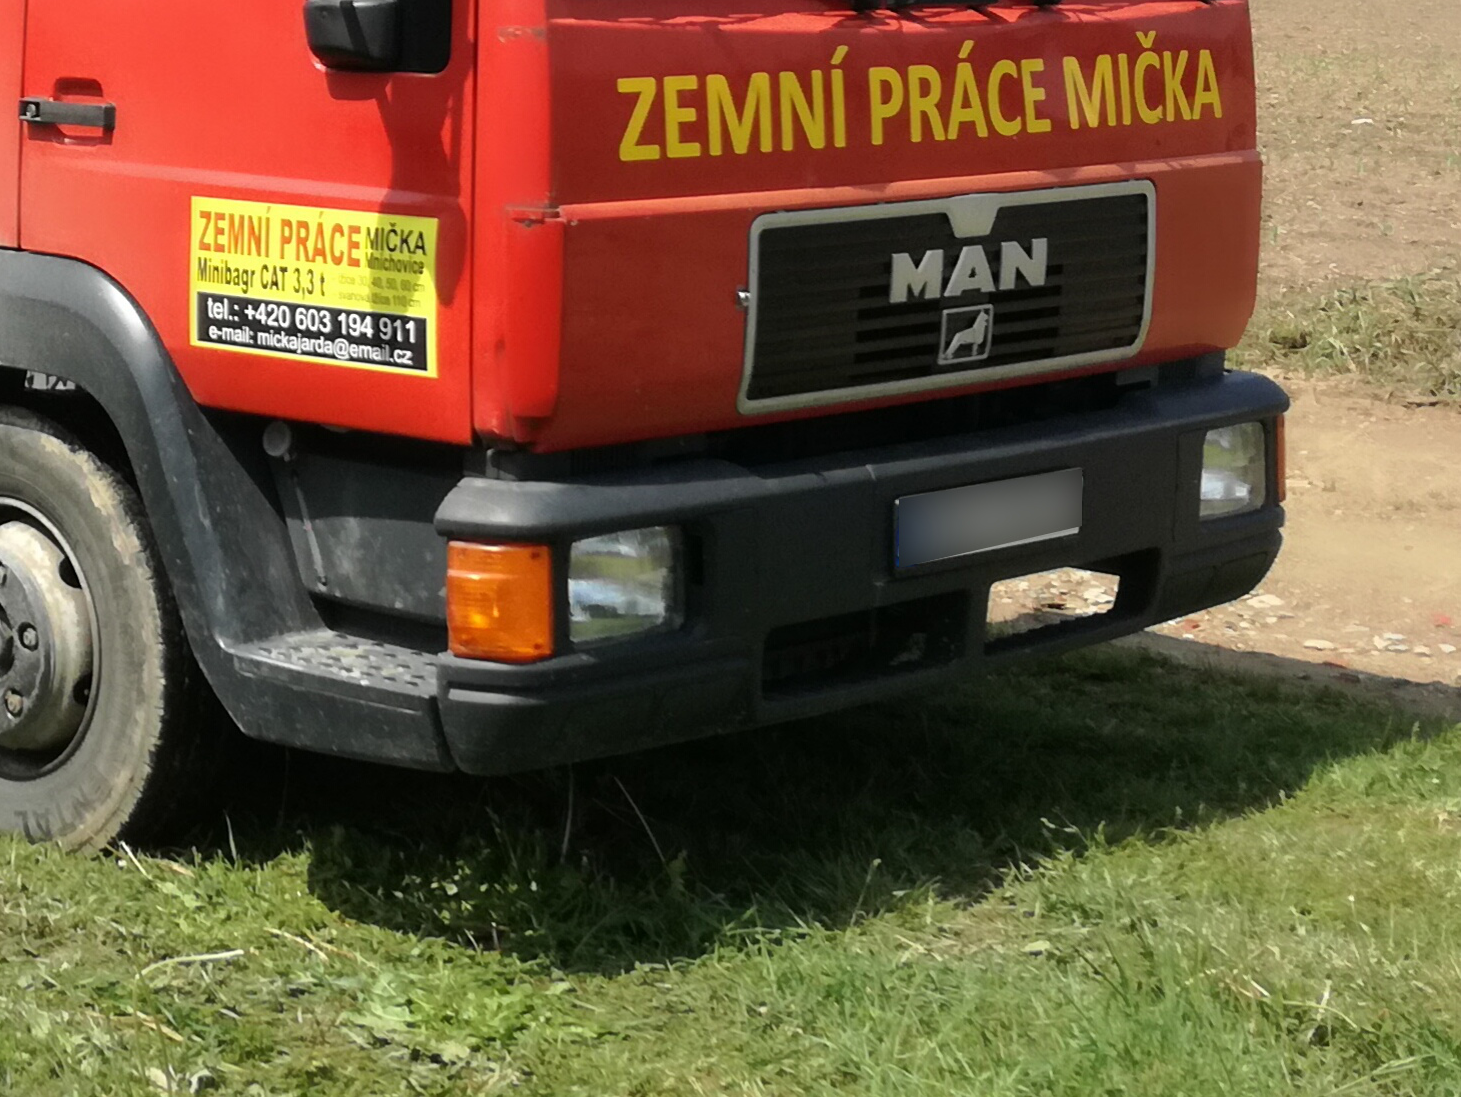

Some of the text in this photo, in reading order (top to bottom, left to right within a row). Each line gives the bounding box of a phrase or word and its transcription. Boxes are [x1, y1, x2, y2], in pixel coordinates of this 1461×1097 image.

[616, 30, 1223, 161] ZEMNÍ PRÁCE MIČKA
[198, 206, 427, 268] ZEMNÍ PRÁCE MIČKA
[197, 257, 256, 294] Minibagr
[260, 264, 288, 292] CAT
[293, 268, 315, 300] 3,3
[320, 272, 325, 296] t
[888, 237, 1048, 304] MAN
[207, 297, 416, 343] tel.: +420 603 194 911
[208, 325, 414, 365] e-mail: mickajarda@email.cz
